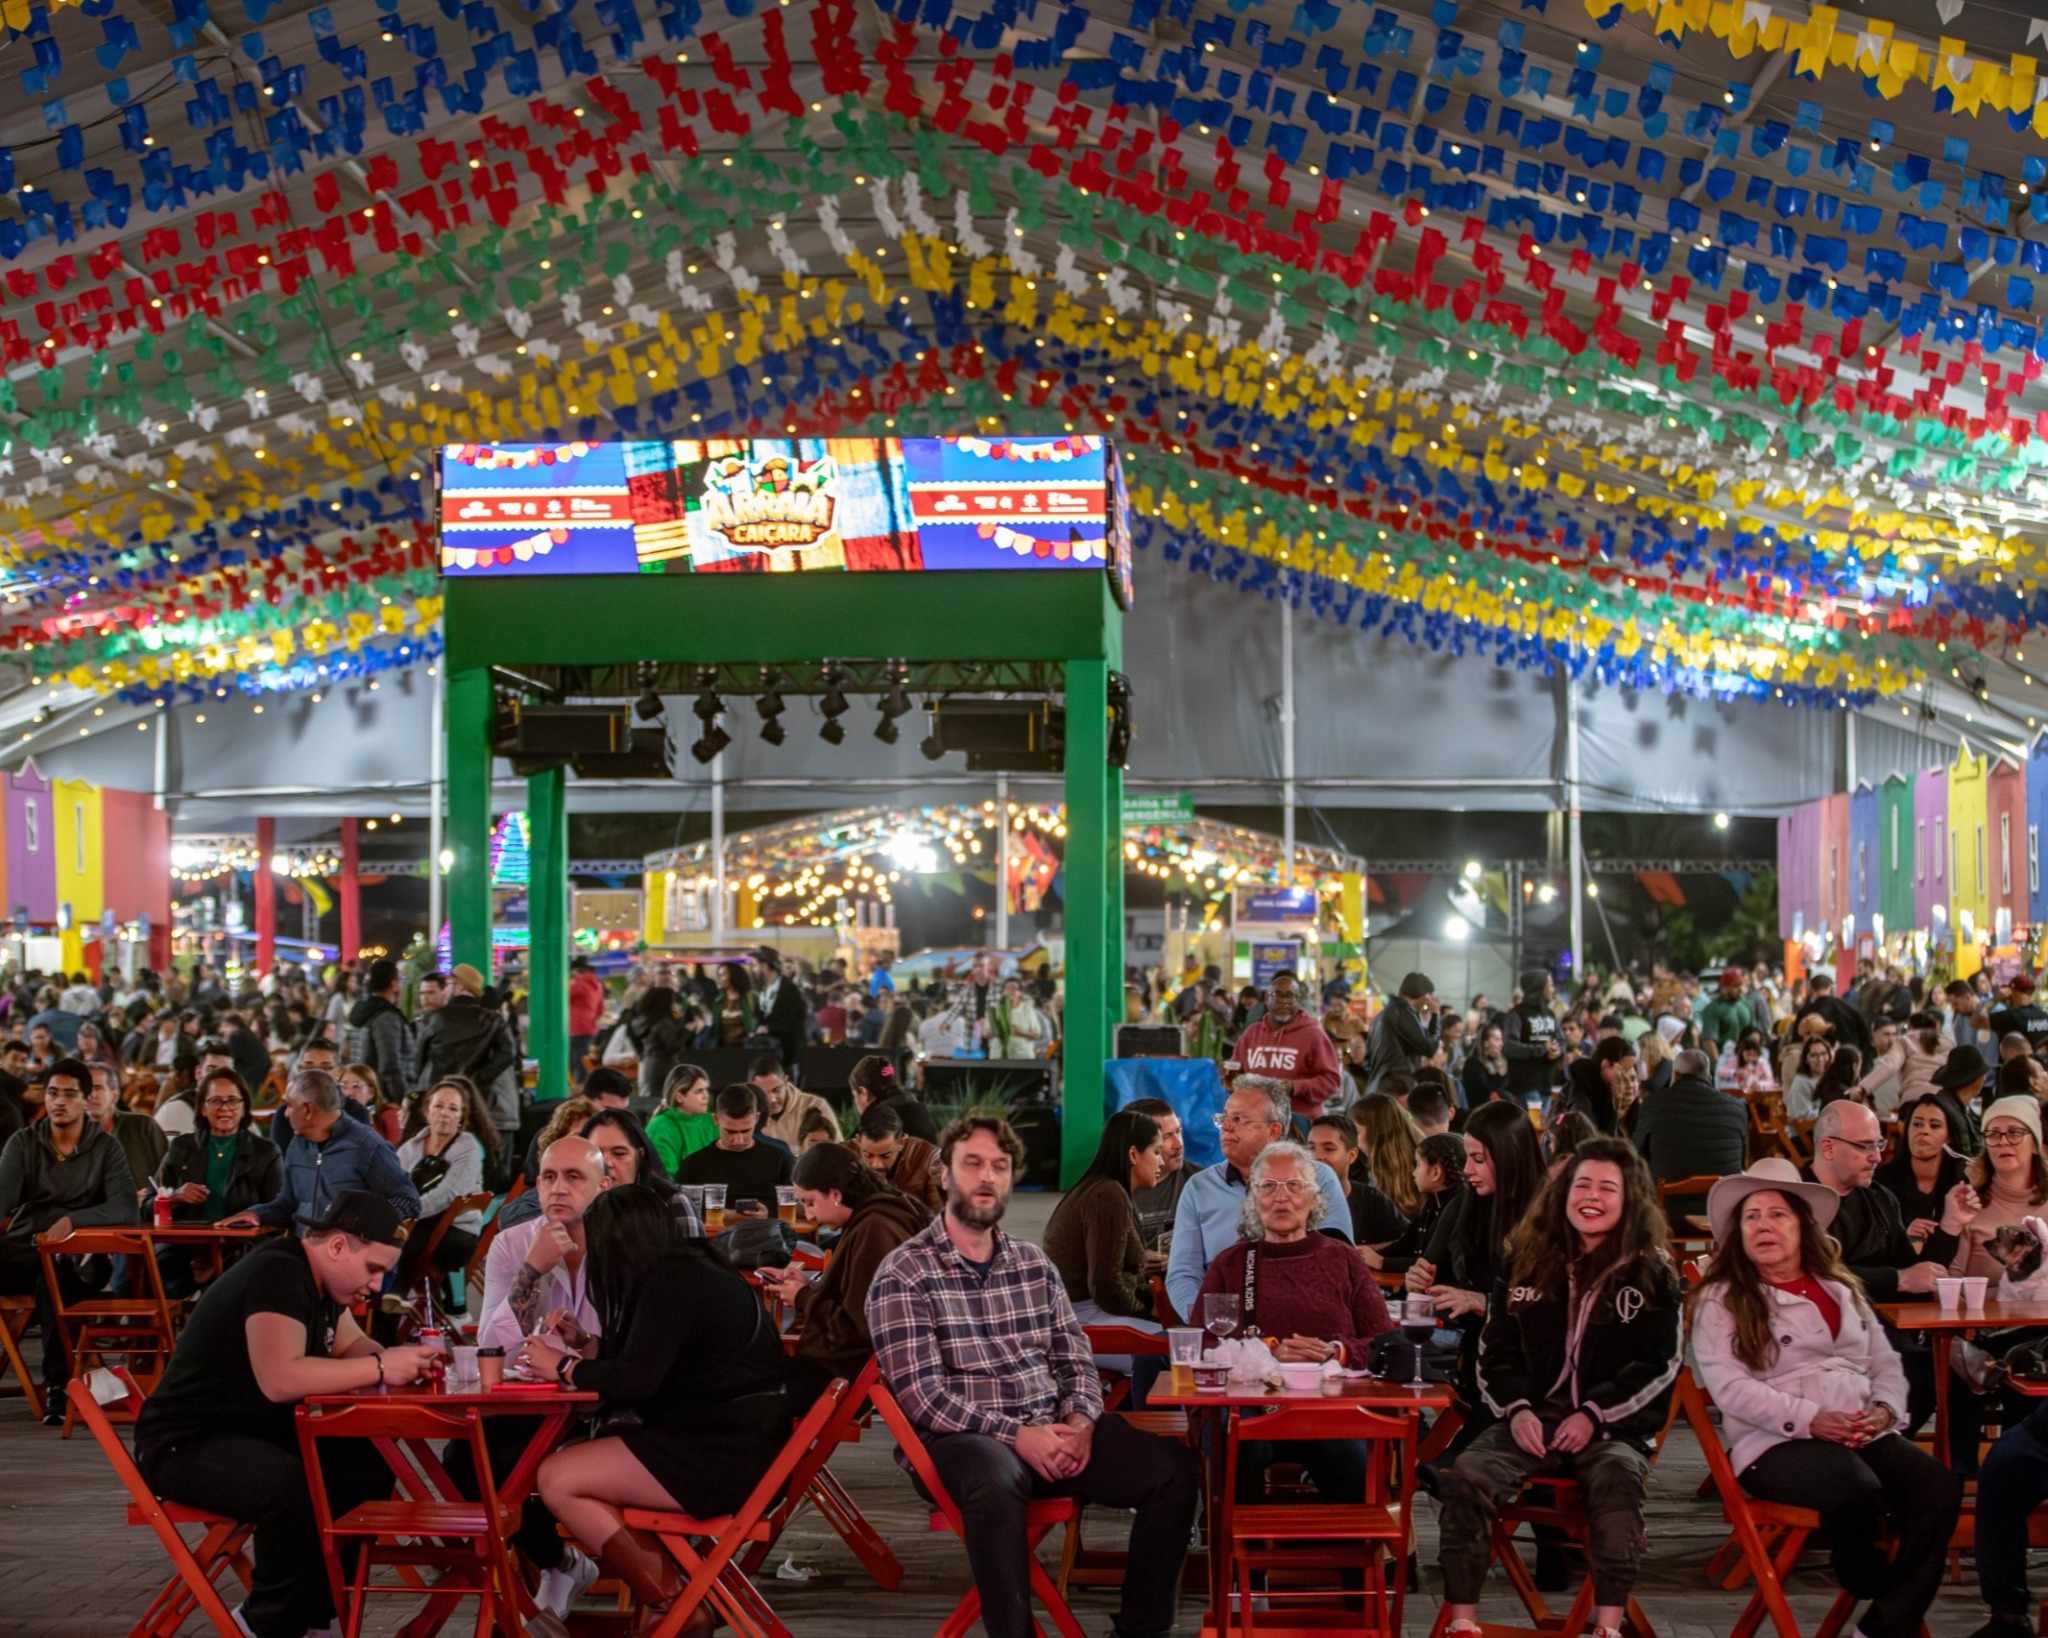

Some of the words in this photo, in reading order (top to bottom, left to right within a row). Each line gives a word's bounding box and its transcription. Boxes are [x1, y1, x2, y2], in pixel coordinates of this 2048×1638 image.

[734, 524, 813, 545] CAIÇARA
[1247, 1046, 1298, 1071] VANS
[1245, 1249, 1257, 1287] MICHAEL
[1244, 1287, 1255, 1311] KORS
